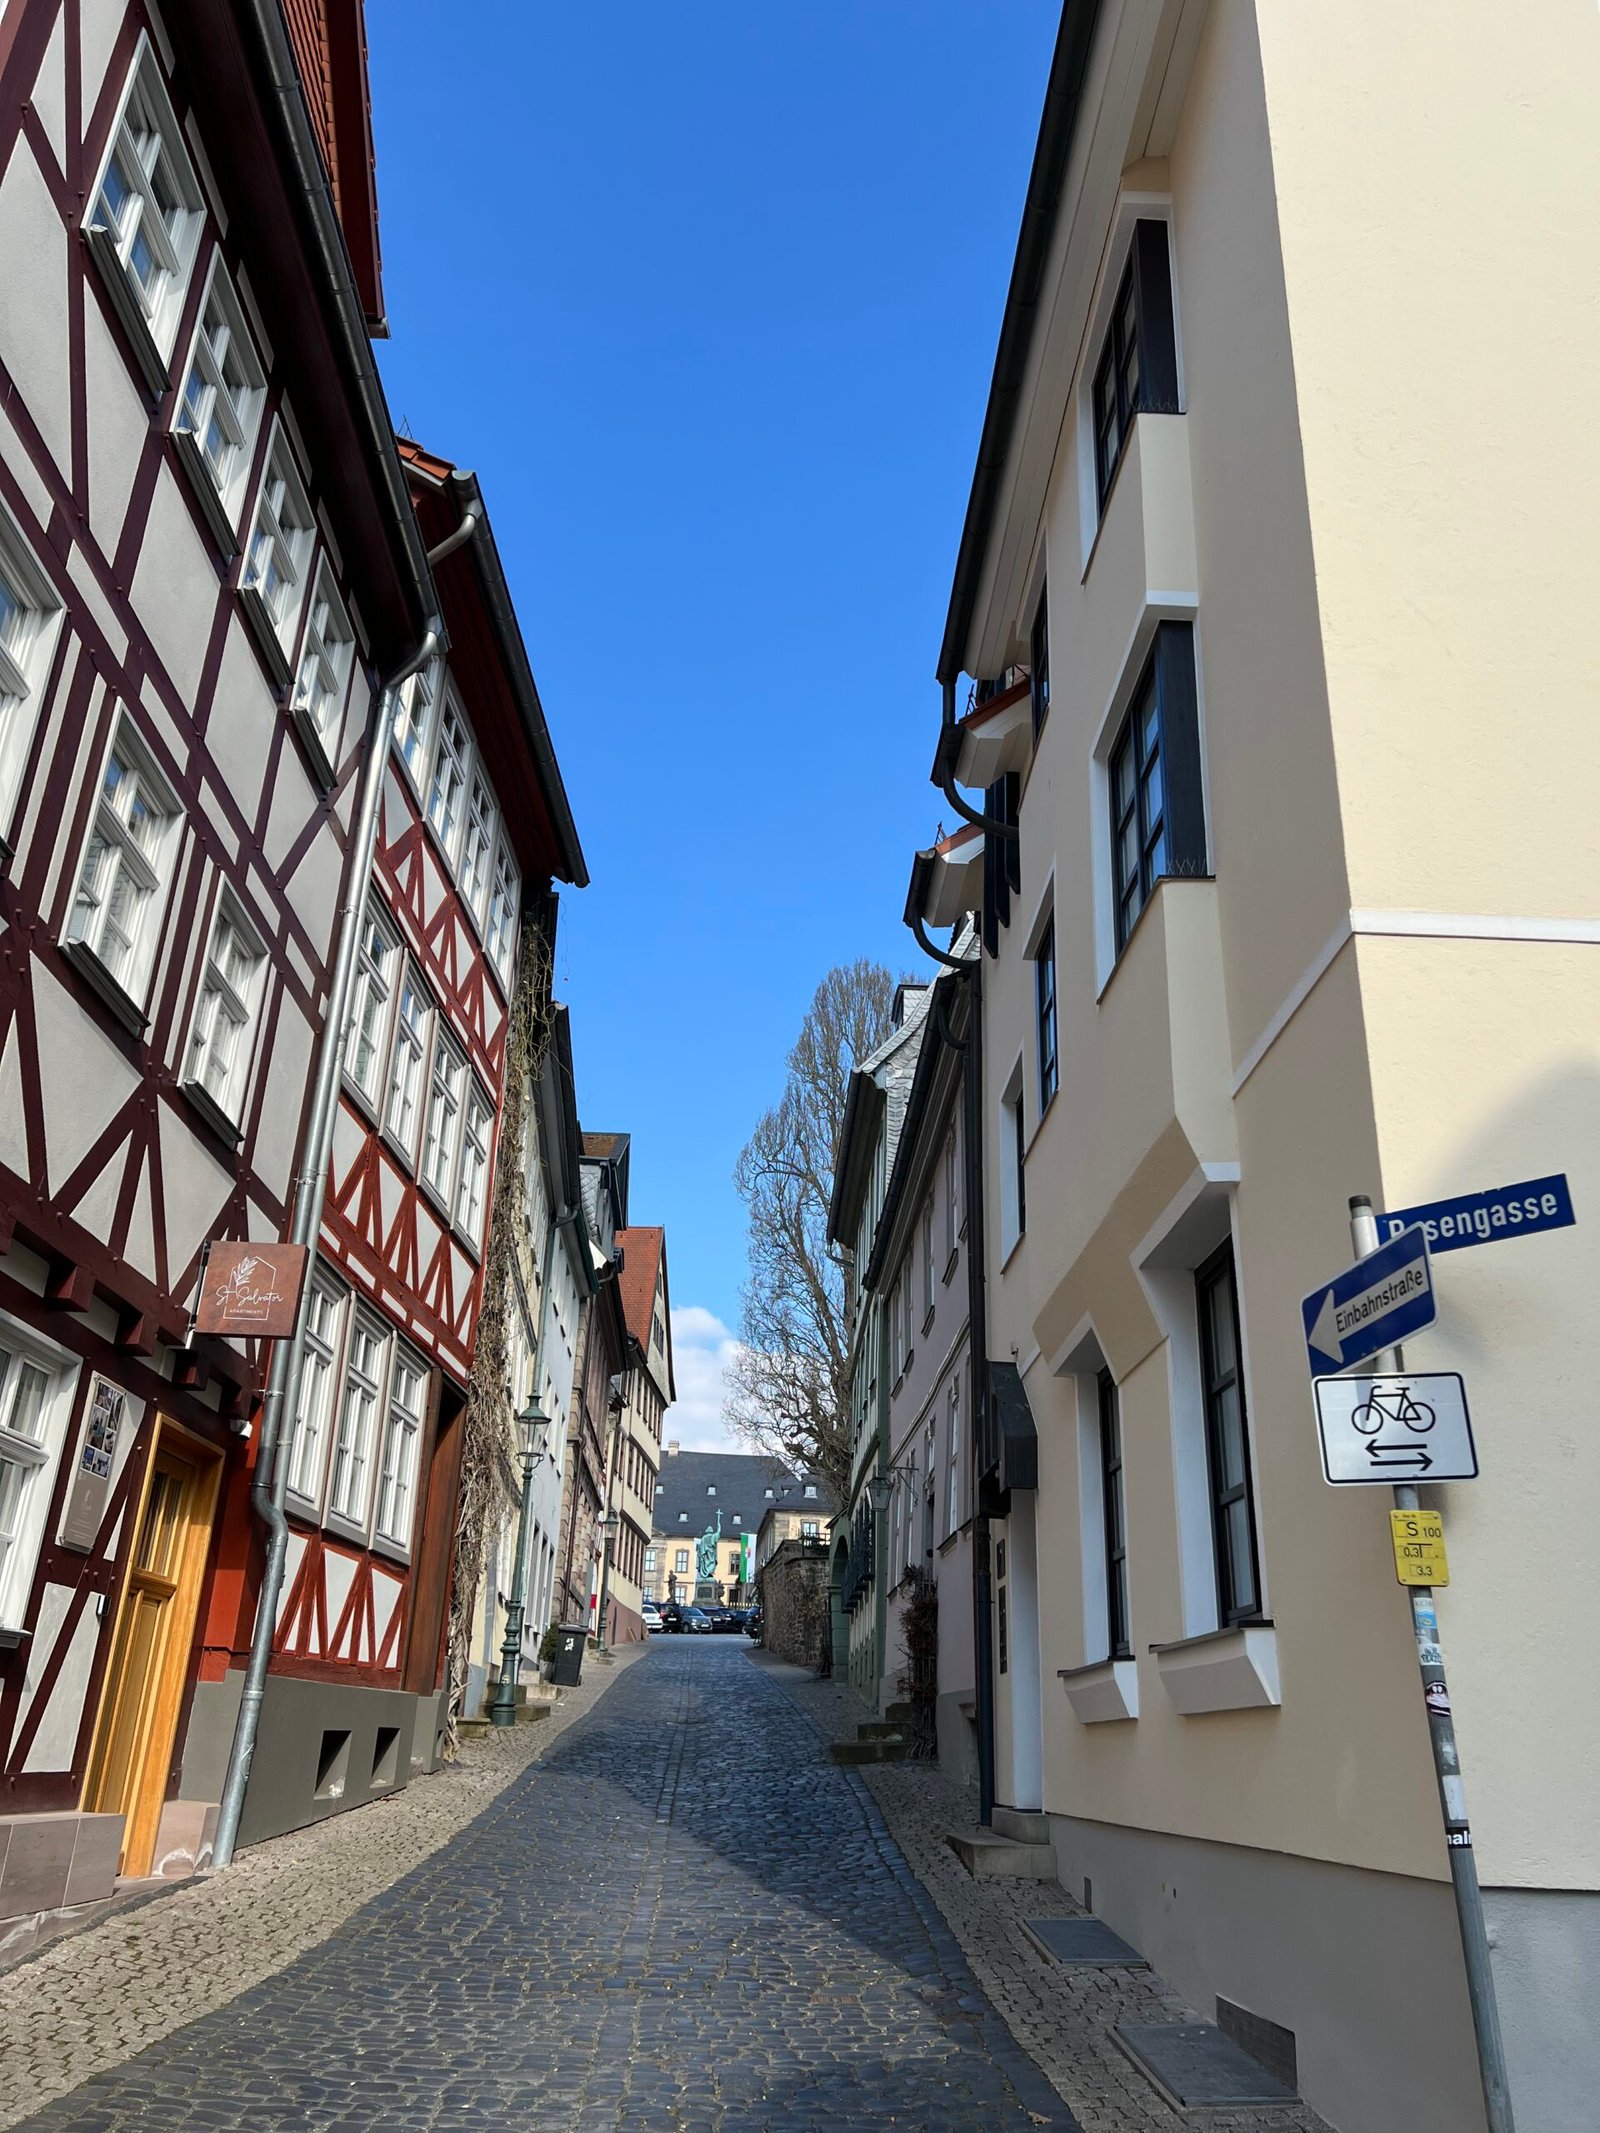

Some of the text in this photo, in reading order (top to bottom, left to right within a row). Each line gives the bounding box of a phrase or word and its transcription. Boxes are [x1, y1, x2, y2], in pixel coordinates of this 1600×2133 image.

[216, 1285, 283, 1306] St Salvator
[1335, 1269, 1424, 1333] Einbahnstraße
[1406, 1521, 1441, 1538] S 100
[1416, 1565, 1433, 1577] 3.3
